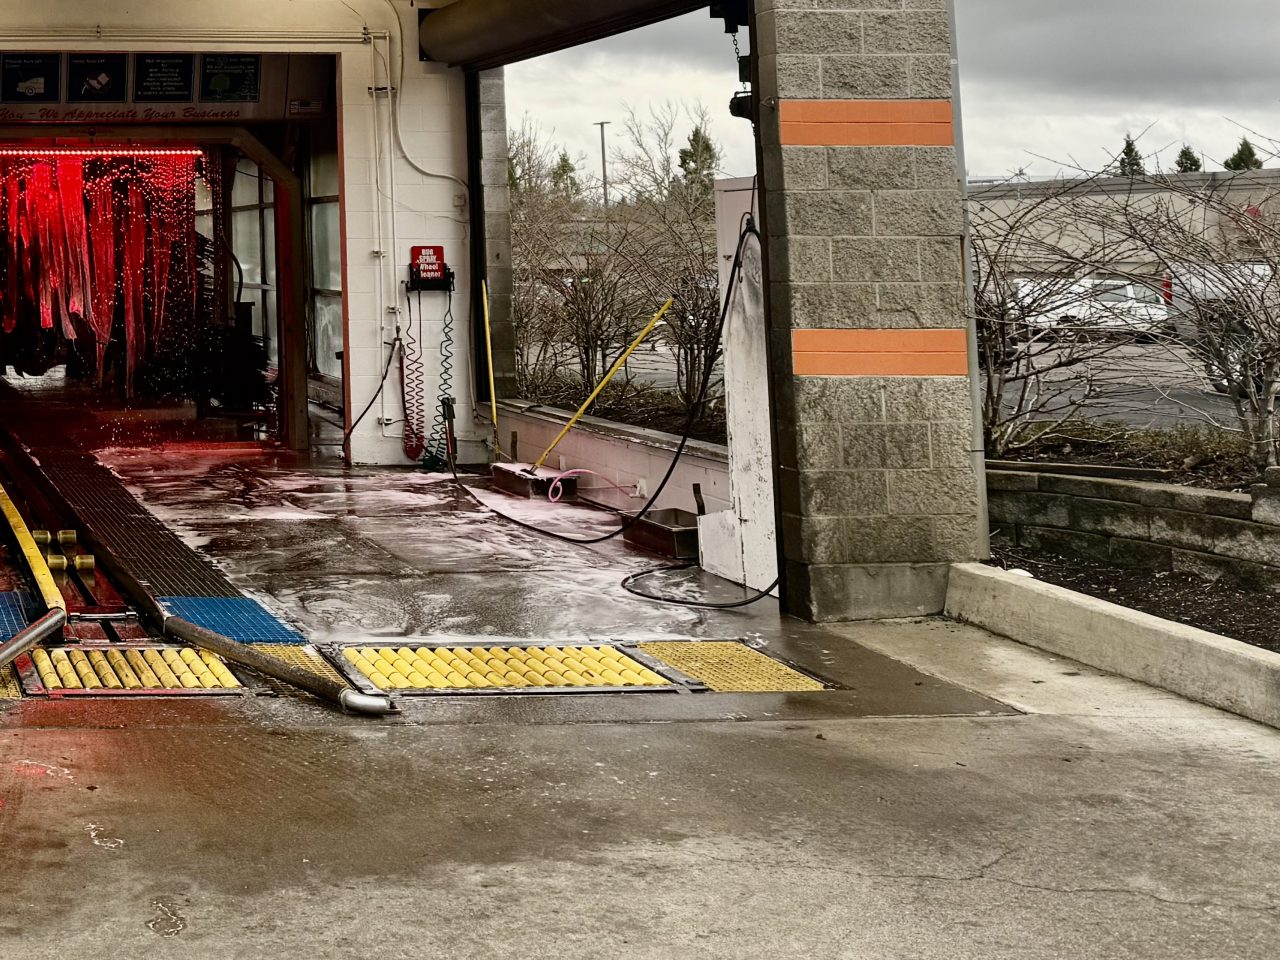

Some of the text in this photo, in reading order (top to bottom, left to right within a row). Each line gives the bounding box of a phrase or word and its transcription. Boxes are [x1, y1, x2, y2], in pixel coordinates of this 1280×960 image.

[0, 107, 24, 119] You
[39, 108, 58, 119] We
[62, 107, 137, 120] Appreciate
[143, 108, 176, 120] Your
[183, 107, 240, 118] Business
